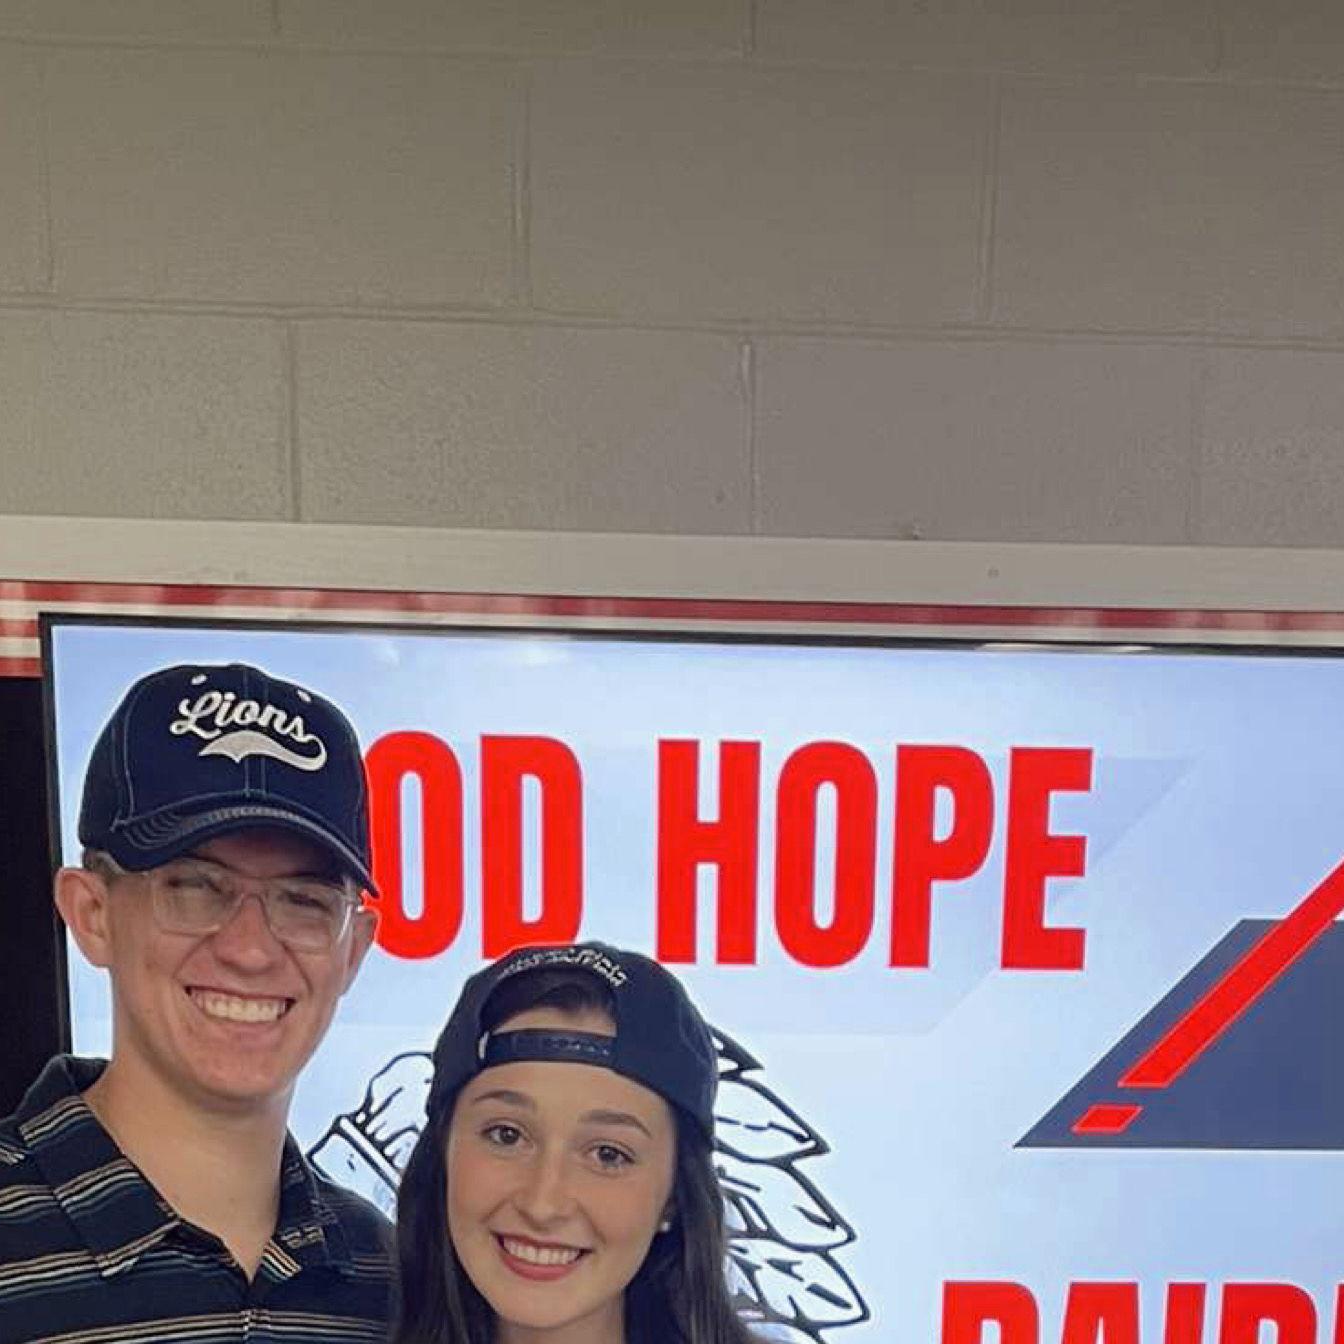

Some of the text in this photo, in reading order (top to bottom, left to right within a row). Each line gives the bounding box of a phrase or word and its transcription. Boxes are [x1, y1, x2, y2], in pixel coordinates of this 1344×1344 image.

[169, 690, 311, 741] Lions
[361, 730, 1094, 971] OD HOPE
